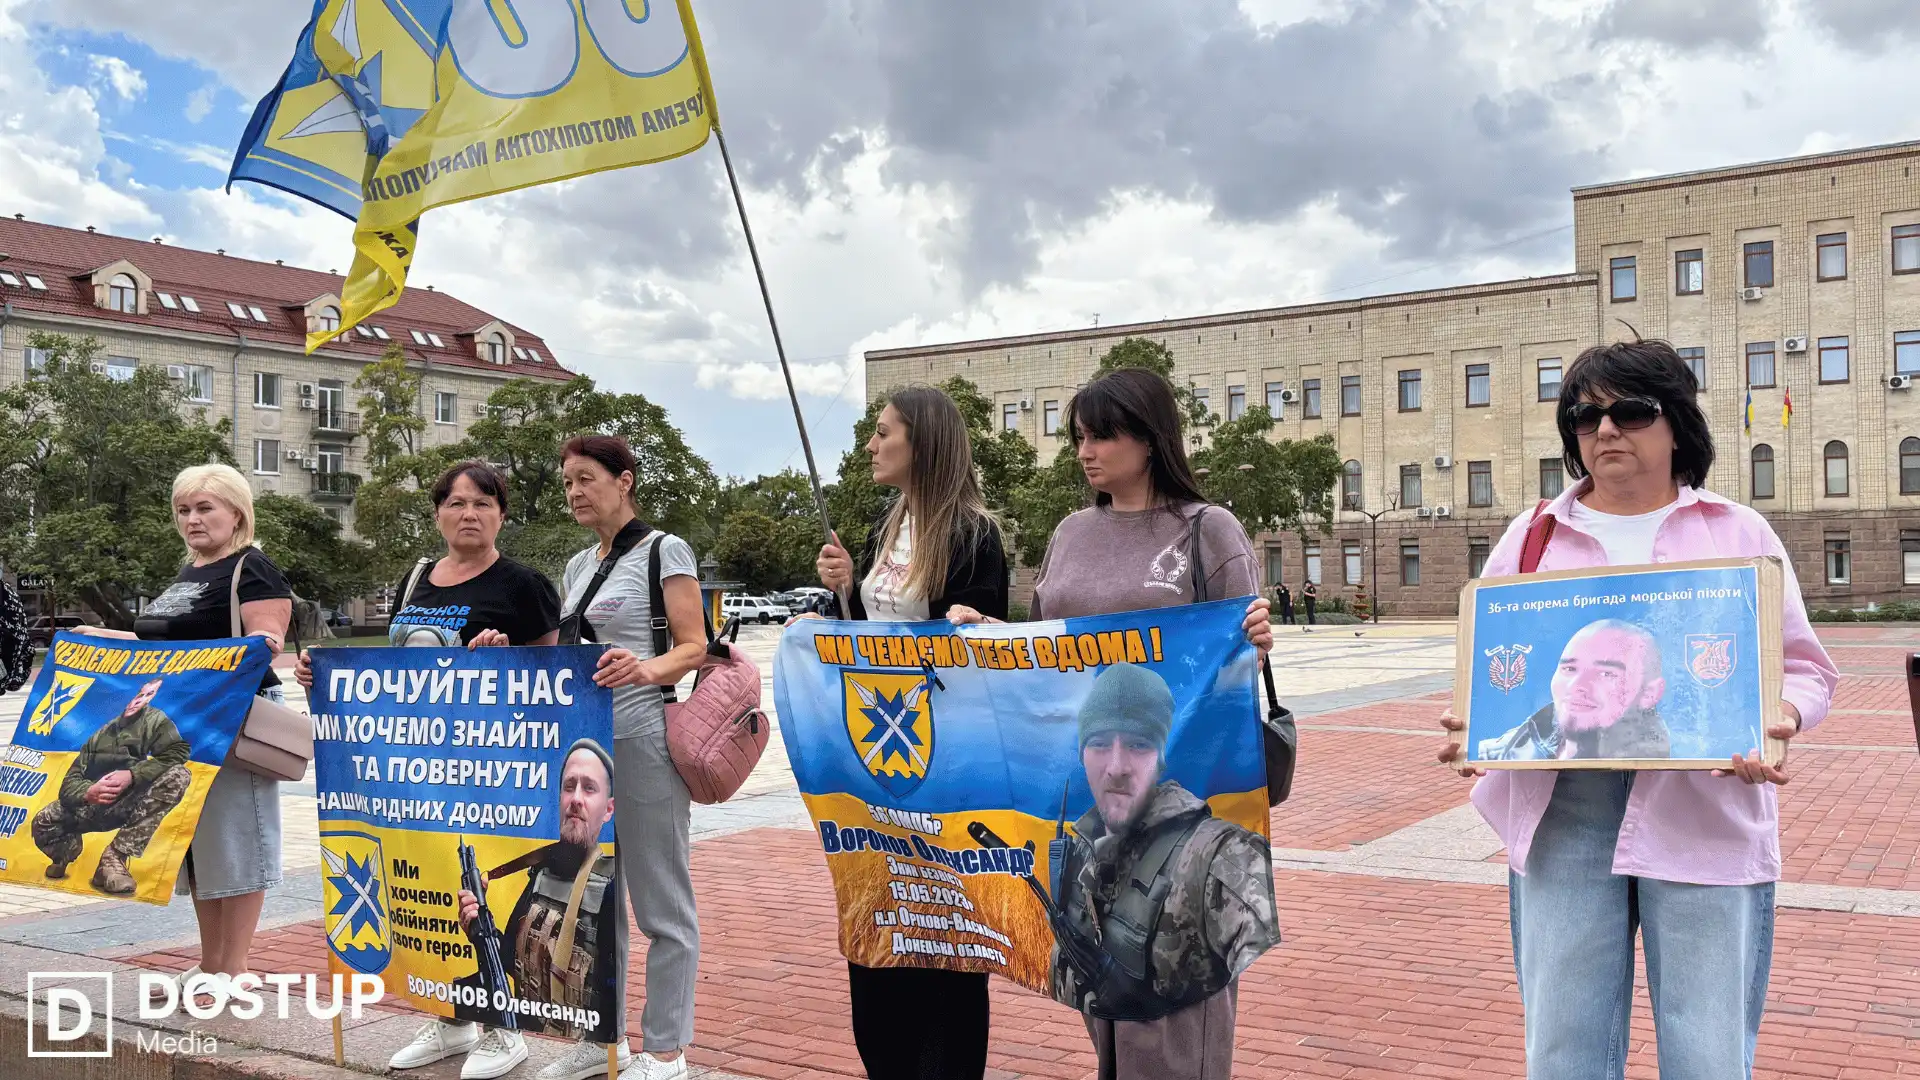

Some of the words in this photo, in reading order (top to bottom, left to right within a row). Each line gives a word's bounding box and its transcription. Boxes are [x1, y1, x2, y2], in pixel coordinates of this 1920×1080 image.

[397, 604, 471, 616] ОРОНОВ
[1487, 602, 1519, 614] 36-та
[1523, 598, 1569, 612] окрема
[1573, 593, 1626, 609] бригада
[1631, 588, 1693, 604] морської
[1697, 586, 1742, 601] піхоти
[392, 615, 467, 630] лександр
[124, 650, 172, 675] ТЕБЕ
[814, 633, 855, 666] МИ
[858, 635, 968, 668] ЧЕКАЄМО
[966, 638, 1030, 670] ТЕБЕ
[1033, 629, 1151, 673] ВДОМА
[329, 658, 497, 705] ПОЧУЙТЕ
[507, 668, 574, 706] НАС
[312, 714, 342, 741] МИ
[345, 715, 446, 746] ХОЧЕМО
[452, 713, 560, 749] ЗНАЙТИ
[352, 755, 381, 782] ТА
[387, 756, 548, 789] ПОВЕРНУТИ
[372, 798, 446, 823] РІДНИХ
[448, 801, 542, 828] ДОДОМУ
[867, 804, 890, 825] 56
[393, 859, 419, 880] Ми
[391, 886, 453, 907] хочемо
[391, 907, 459, 935] обійняти
[392, 931, 422, 952] свого
[426, 939, 473, 962] героя
[407, 973, 489, 1009] ВОРОНОВ
[493, 990, 601, 1032] Олександр
